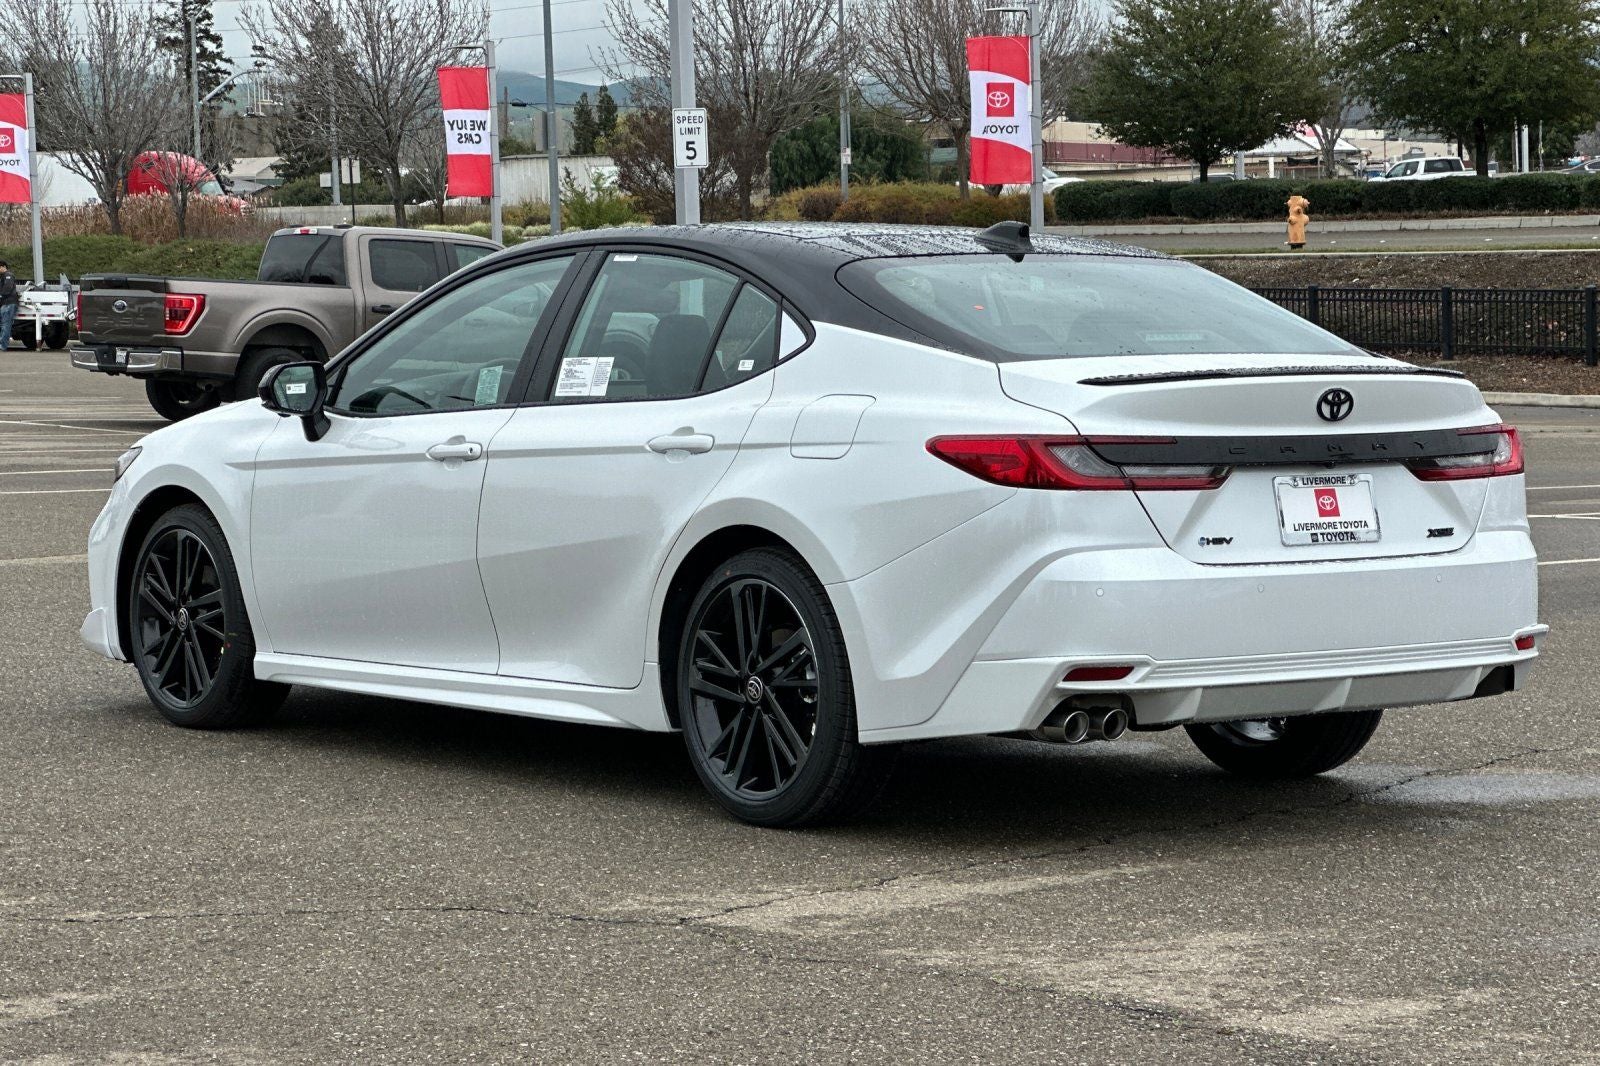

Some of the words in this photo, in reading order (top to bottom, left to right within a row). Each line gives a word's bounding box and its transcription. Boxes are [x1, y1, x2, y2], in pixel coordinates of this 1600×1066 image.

[676, 115, 704, 124] SPEED
[679, 126, 701, 136] LIMIT
[685, 140, 697, 160] 5
[1301, 475, 1347, 486] LIVERMORE
[1292, 521, 1338, 532] LIVERMORE
[1338, 519, 1369, 530] TOYOTA
[1319, 531, 1357, 542] TOYOTA
